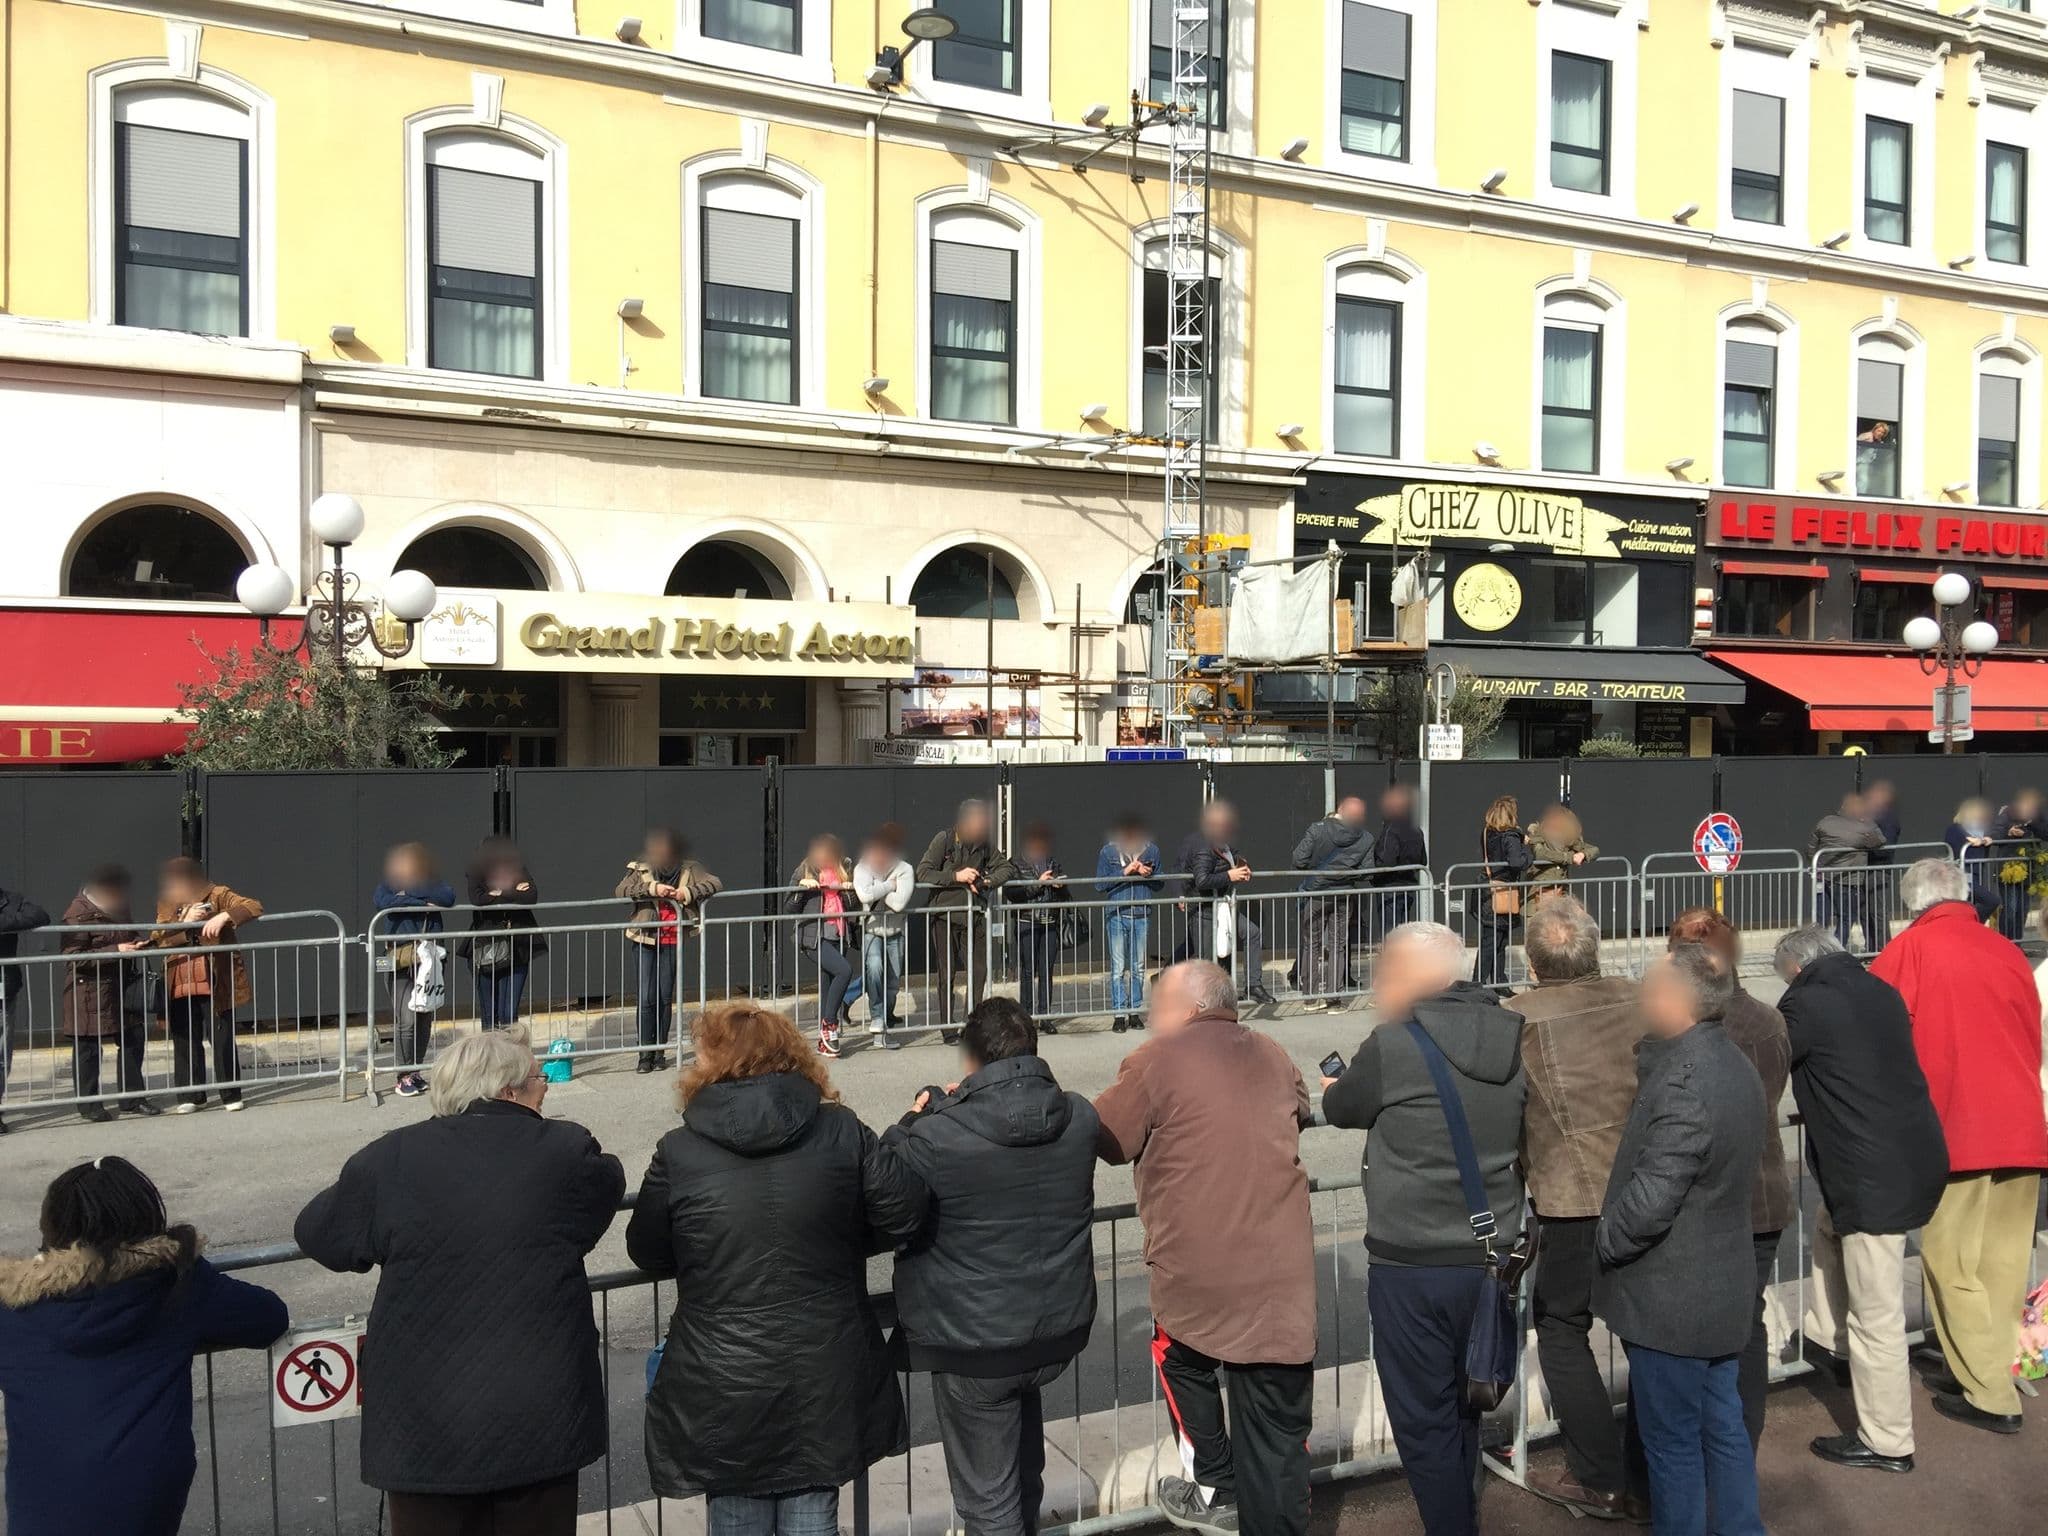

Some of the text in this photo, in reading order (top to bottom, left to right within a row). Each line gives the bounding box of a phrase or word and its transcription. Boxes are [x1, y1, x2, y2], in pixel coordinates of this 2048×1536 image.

[1296, 513, 1359, 528] EPICERIE FINE
[1408, 487, 1574, 539] CHEZ OLIVE
[1627, 518, 1692, 537] Cuisine maison
[1721, 502, 2048, 557] LE FELIX FAUR
[1621, 536, 1696, 554] méditerranéenne
[520, 613, 912, 657] Grand Hôtel Aston
[1131, 684, 1149, 696] Gra
[1553, 682, 1588, 697] BAR
[1602, 683, 1686, 700] TRAITEUR
[0, 727, 96, 759] IE
